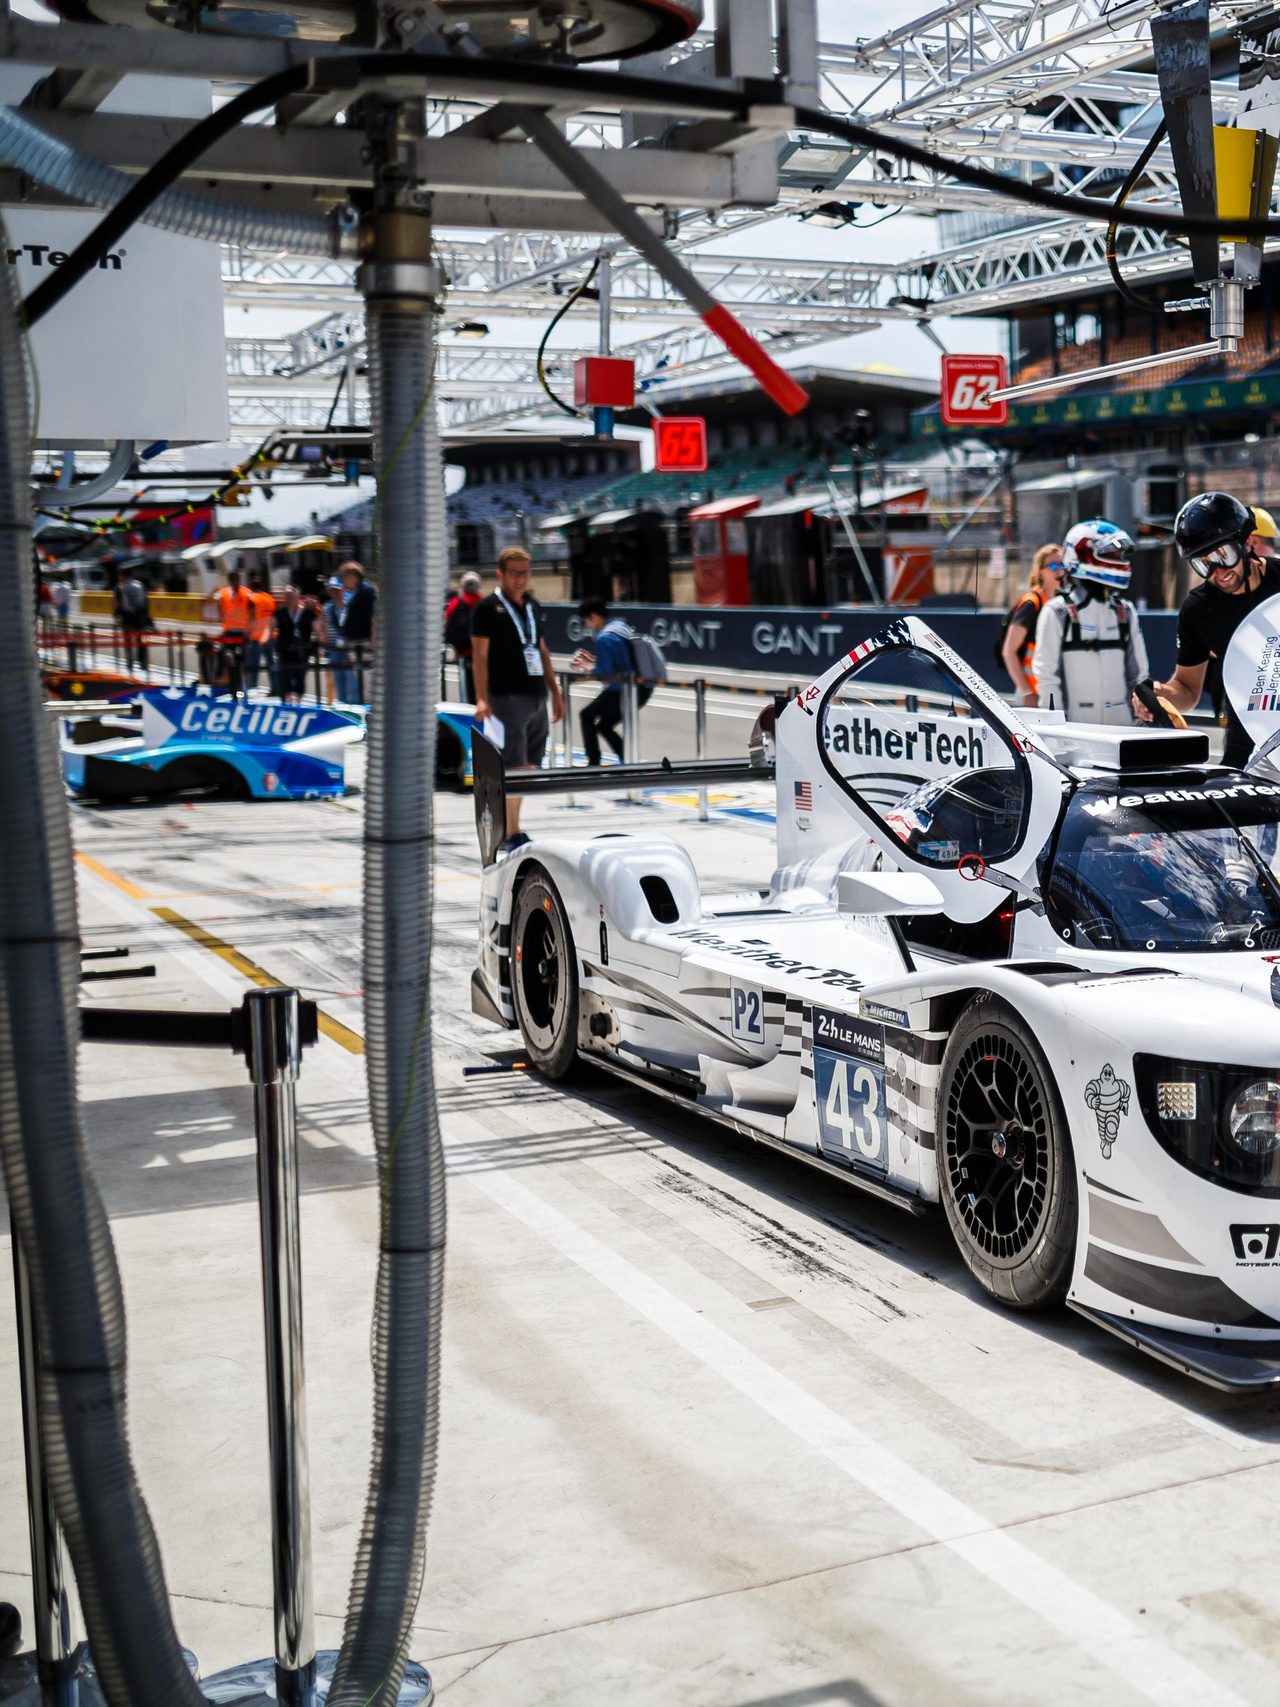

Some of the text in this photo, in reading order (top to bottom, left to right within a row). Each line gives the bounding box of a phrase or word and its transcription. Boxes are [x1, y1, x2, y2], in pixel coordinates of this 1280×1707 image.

[950, 374, 999, 410] 62
[660, 425, 701, 465] 65
[652, 617, 722, 650] GANT
[752, 621, 843, 657] GANT
[1252, 636, 1278, 694] Ben Keating
[967, 675, 995, 702] Taylor
[181, 701, 318, 737] Cetilar
[824, 717, 984, 768] atherTech
[733, 987, 762, 1034] P2
[869, 1005, 905, 1023] MICHELIN
[818, 1014, 881, 1052] 24h LE MANS
[825, 1059, 881, 1160] 43
